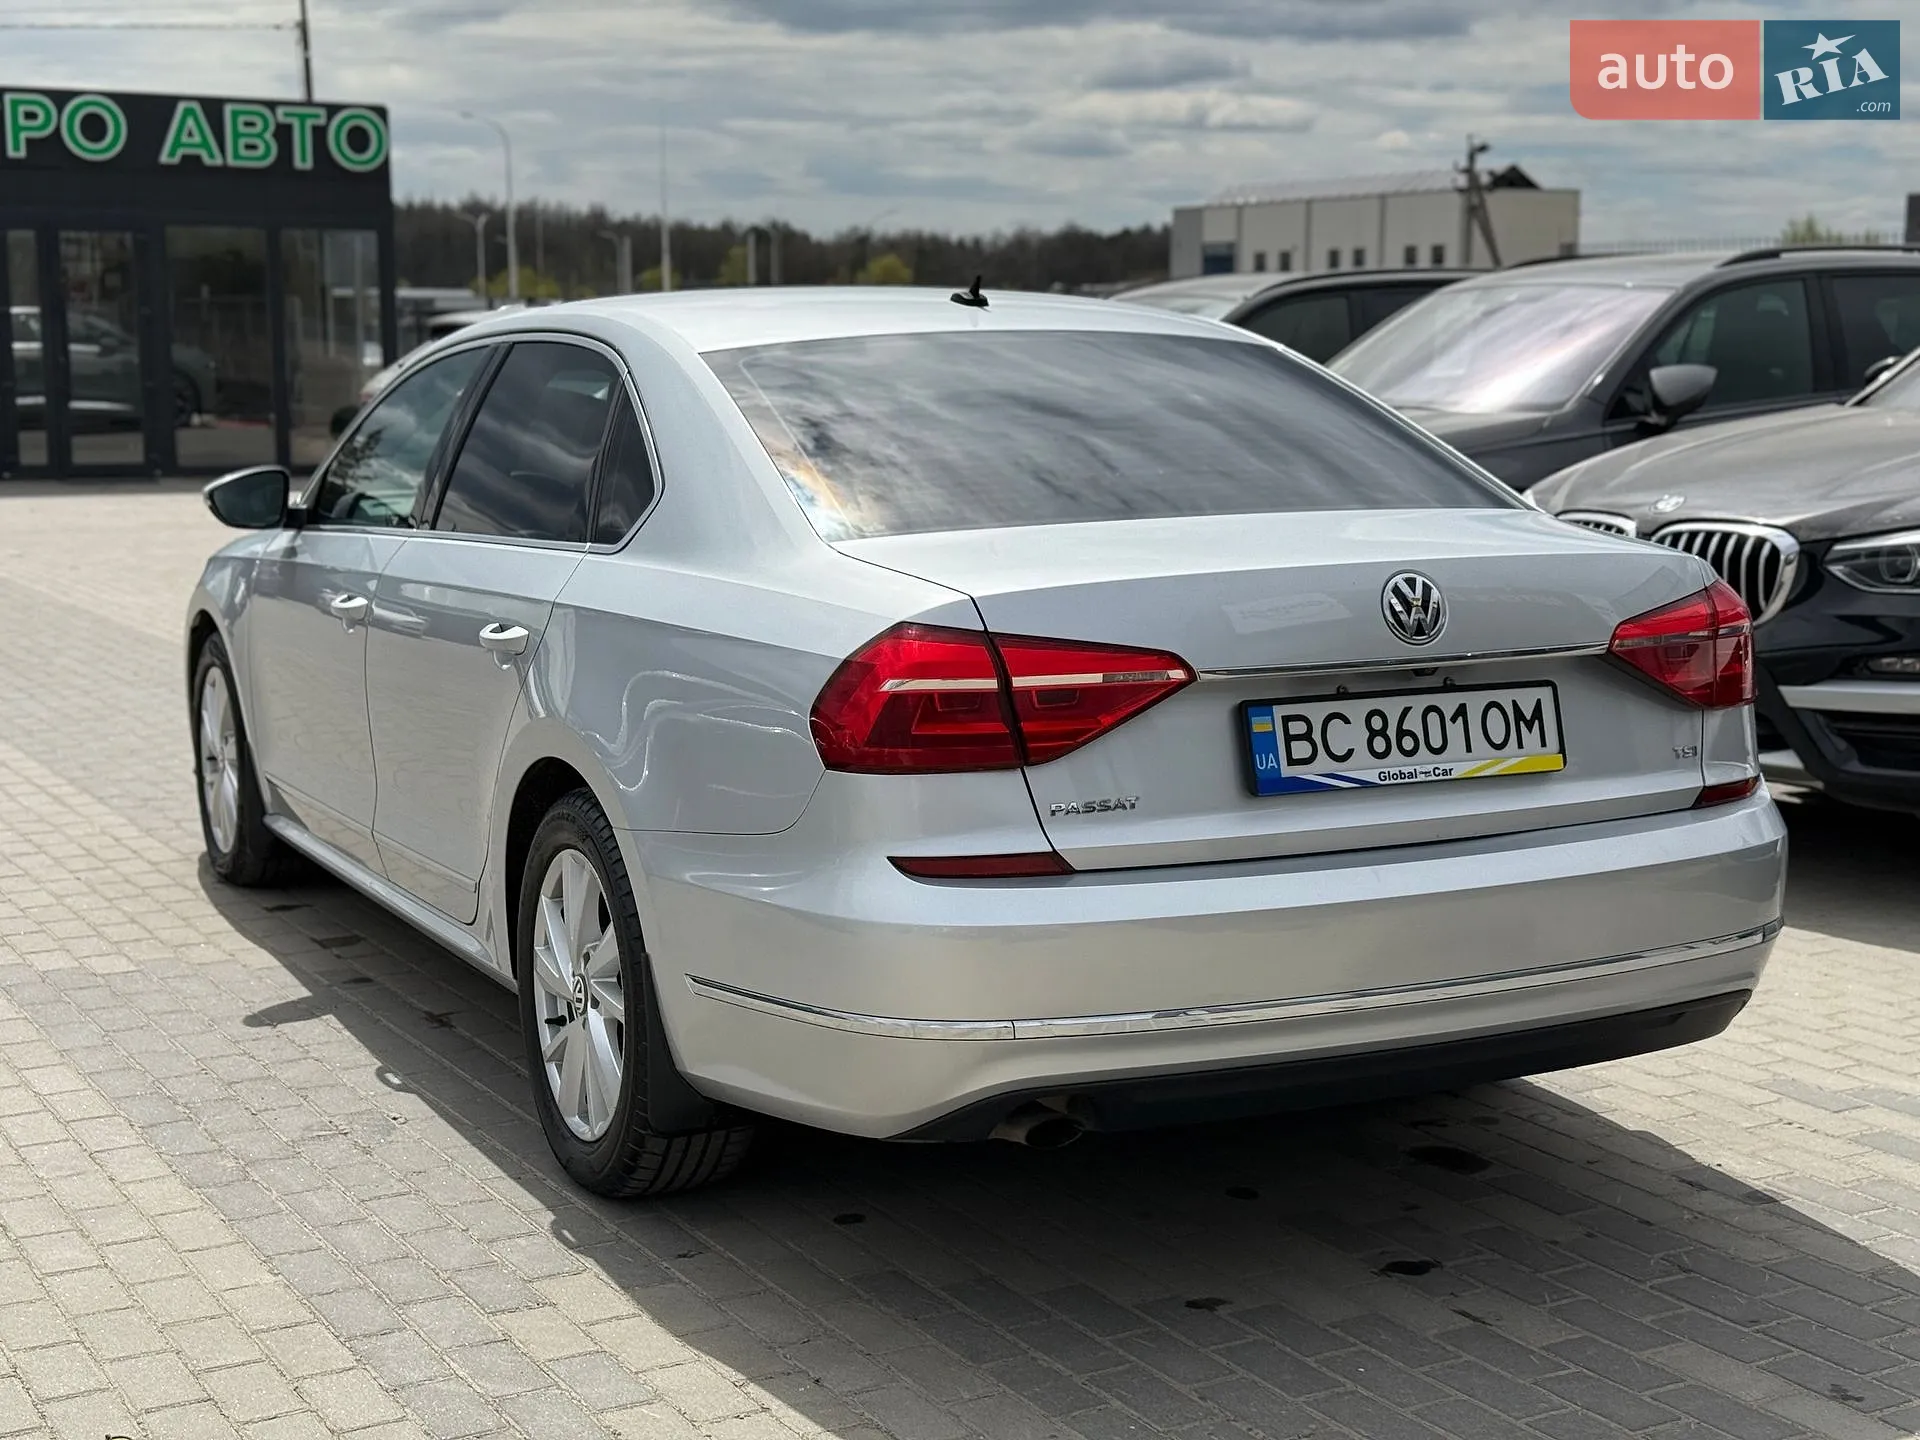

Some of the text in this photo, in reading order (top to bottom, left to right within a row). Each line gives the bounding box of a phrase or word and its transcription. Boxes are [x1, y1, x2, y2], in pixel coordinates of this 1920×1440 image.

[158, 100, 389, 172] АВТО
[1281, 698, 1547, 767] BC 8601 OM
[1256, 754, 1279, 770] UA
[1378, 766, 1454, 782] Global Car
[1050, 796, 1140, 817] PASSAT
